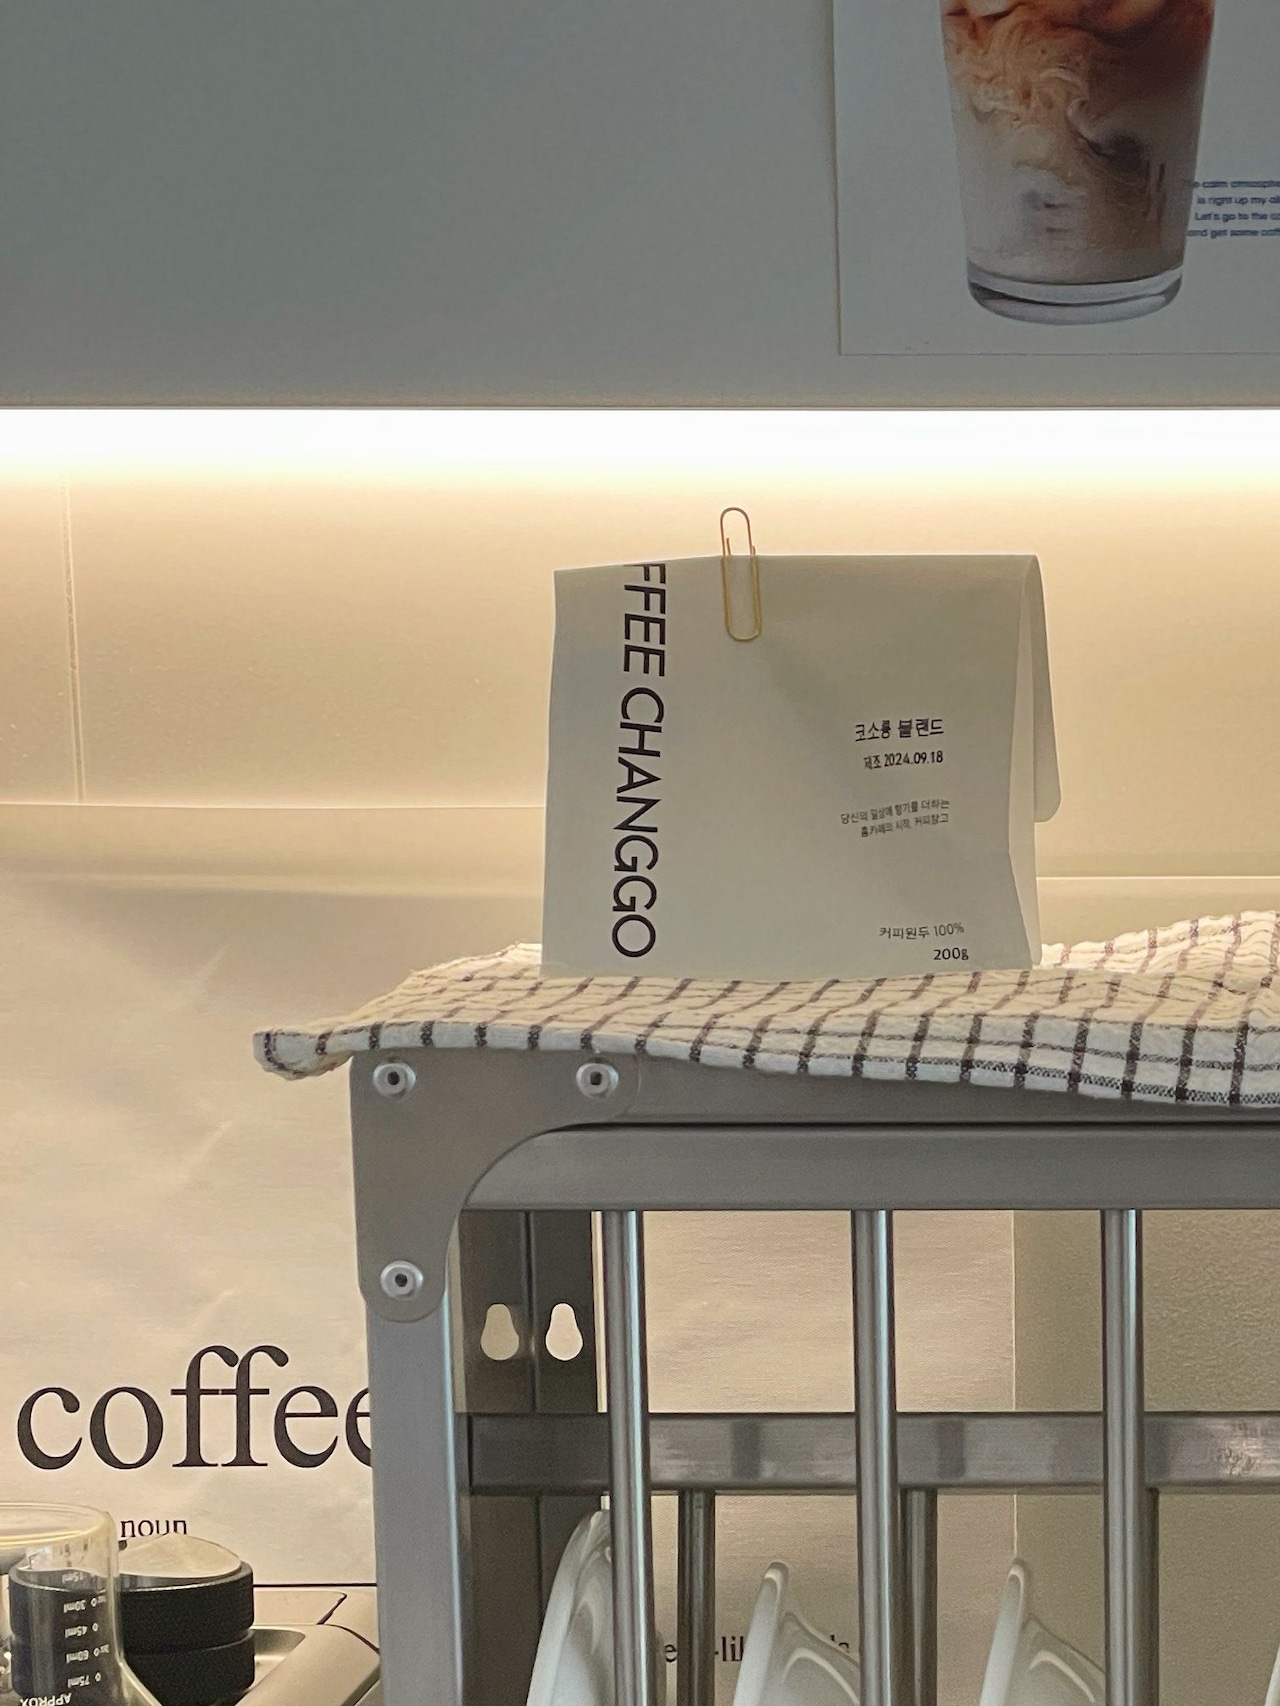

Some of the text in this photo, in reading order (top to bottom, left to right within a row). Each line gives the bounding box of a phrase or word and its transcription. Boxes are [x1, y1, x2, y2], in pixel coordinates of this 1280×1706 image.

[1234, 197, 1249, 205] up
[1251, 197, 1266, 206] my
[1222, 213, 1235, 222] go
[1238, 212, 1249, 220] to
[1251, 212, 1268, 220] the
[1210, 229, 1228, 239] get
[884, 750, 944, 768] 2024.09.18
[611, 686, 665, 959] CHANGGO
[879, 922, 965, 940] 커피원두 100%
[933, 947, 969, 961] 200g
[120, 1519, 187, 1538] noun
[63, 1600, 87, 1613] 30ml
[64, 1626, 88, 1638] 45ml
[66, 1650, 89, 1663] 60ml
[67, 1675, 91, 1688] 75ml
